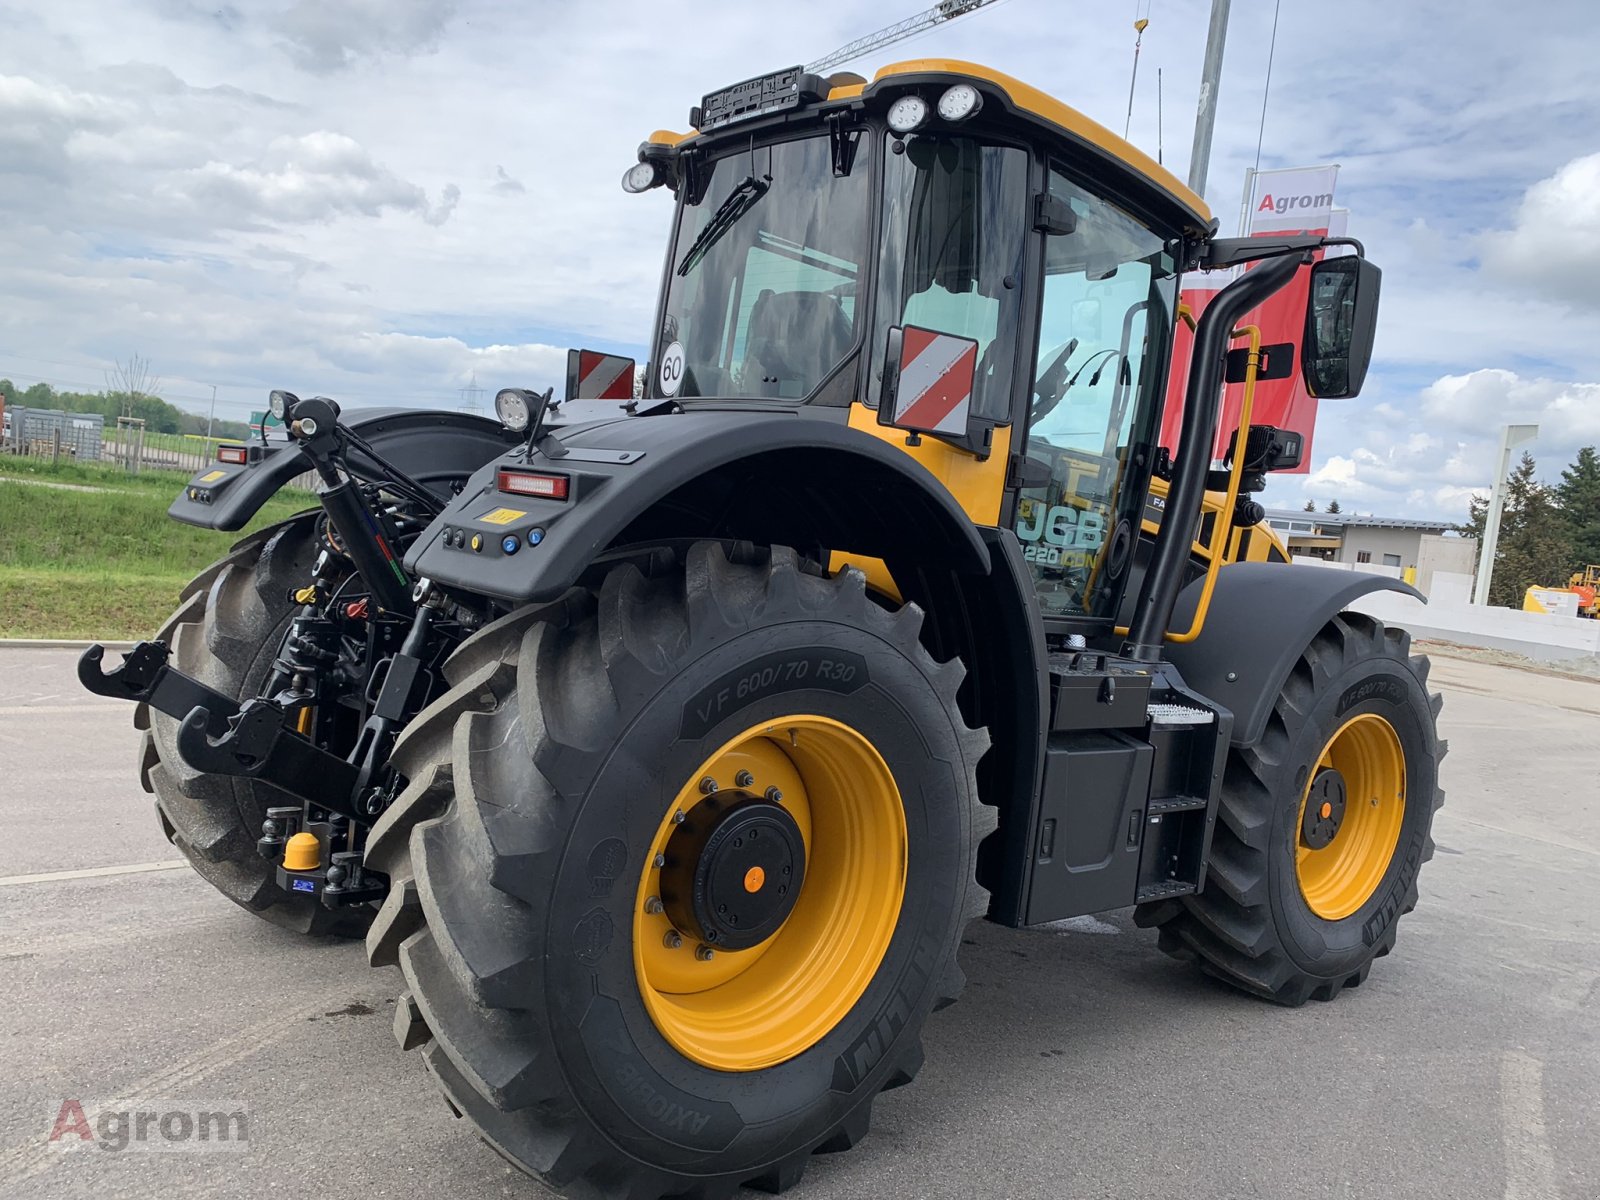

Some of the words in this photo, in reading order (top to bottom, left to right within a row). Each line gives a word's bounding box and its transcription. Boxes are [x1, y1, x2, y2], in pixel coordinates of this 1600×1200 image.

[1258, 193, 1333, 214] Agrom
[662, 355, 682, 382] 60
[1016, 503, 1104, 550] JCB
[1019, 544, 1059, 564] 220
[1060, 550, 1098, 569] ICON
[697, 687, 731, 723] VF
[736, 660, 809, 698] 600/70
[815, 659, 857, 682] R30
